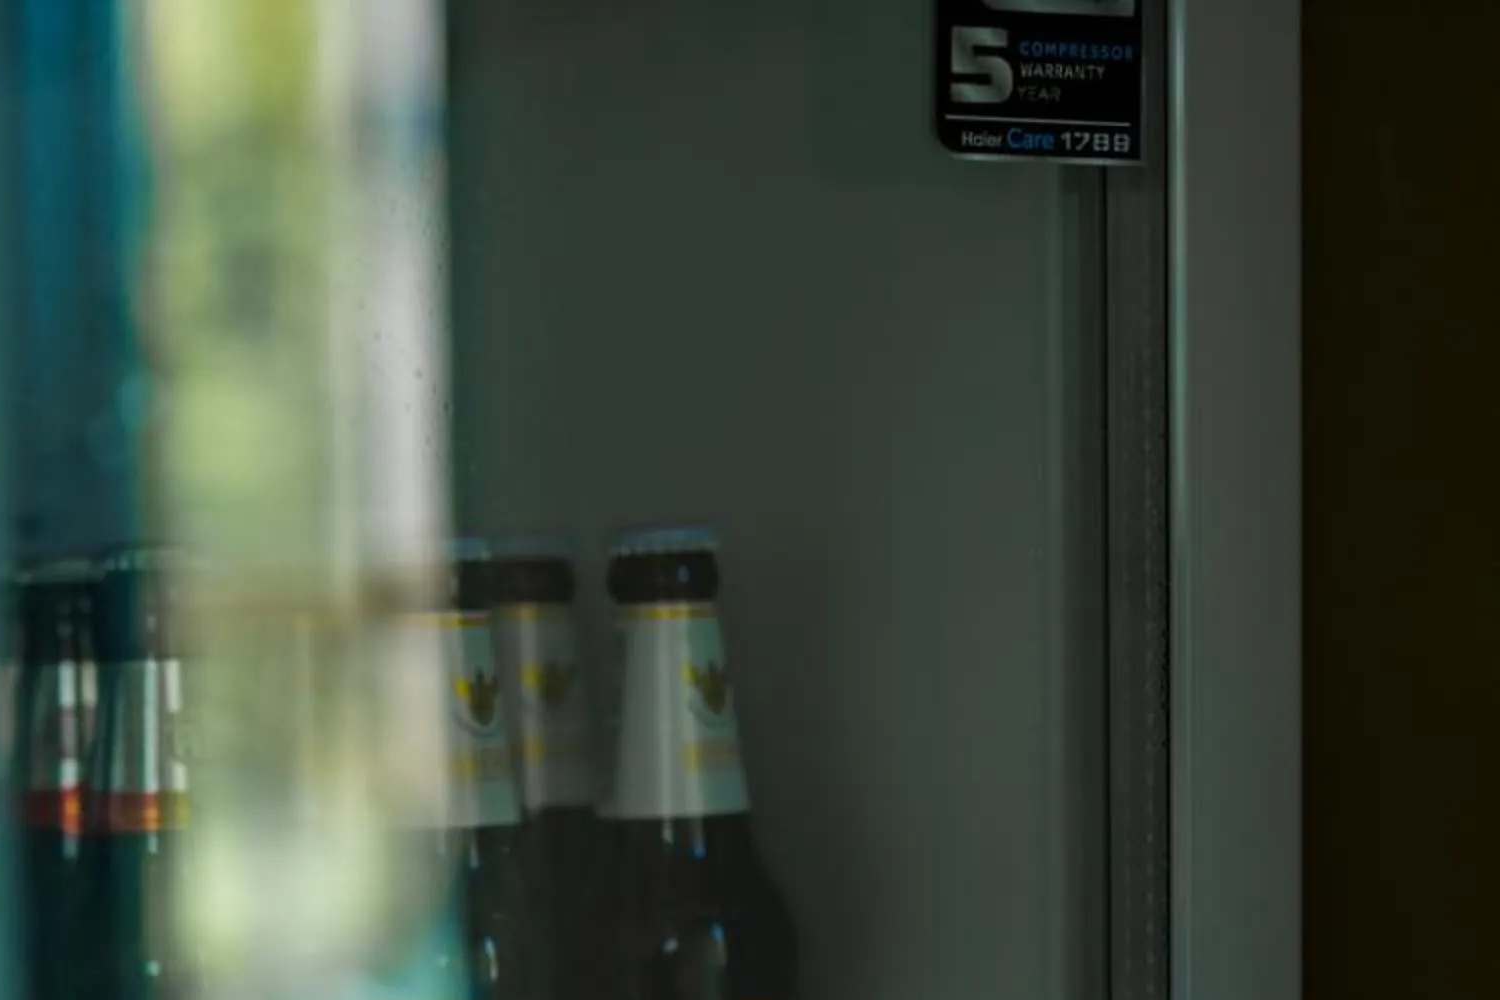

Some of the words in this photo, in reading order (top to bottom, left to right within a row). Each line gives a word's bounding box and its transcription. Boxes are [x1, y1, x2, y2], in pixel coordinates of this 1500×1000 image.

[1019, 40, 1133, 62] COMPRESSOR
[951, 26, 1013, 103] 5
[1019, 61, 1106, 81] WARRANTY
[1016, 84, 1062, 103] YEAR
[961, 131, 1003, 147] Haier
[1007, 127, 1055, 149] Care
